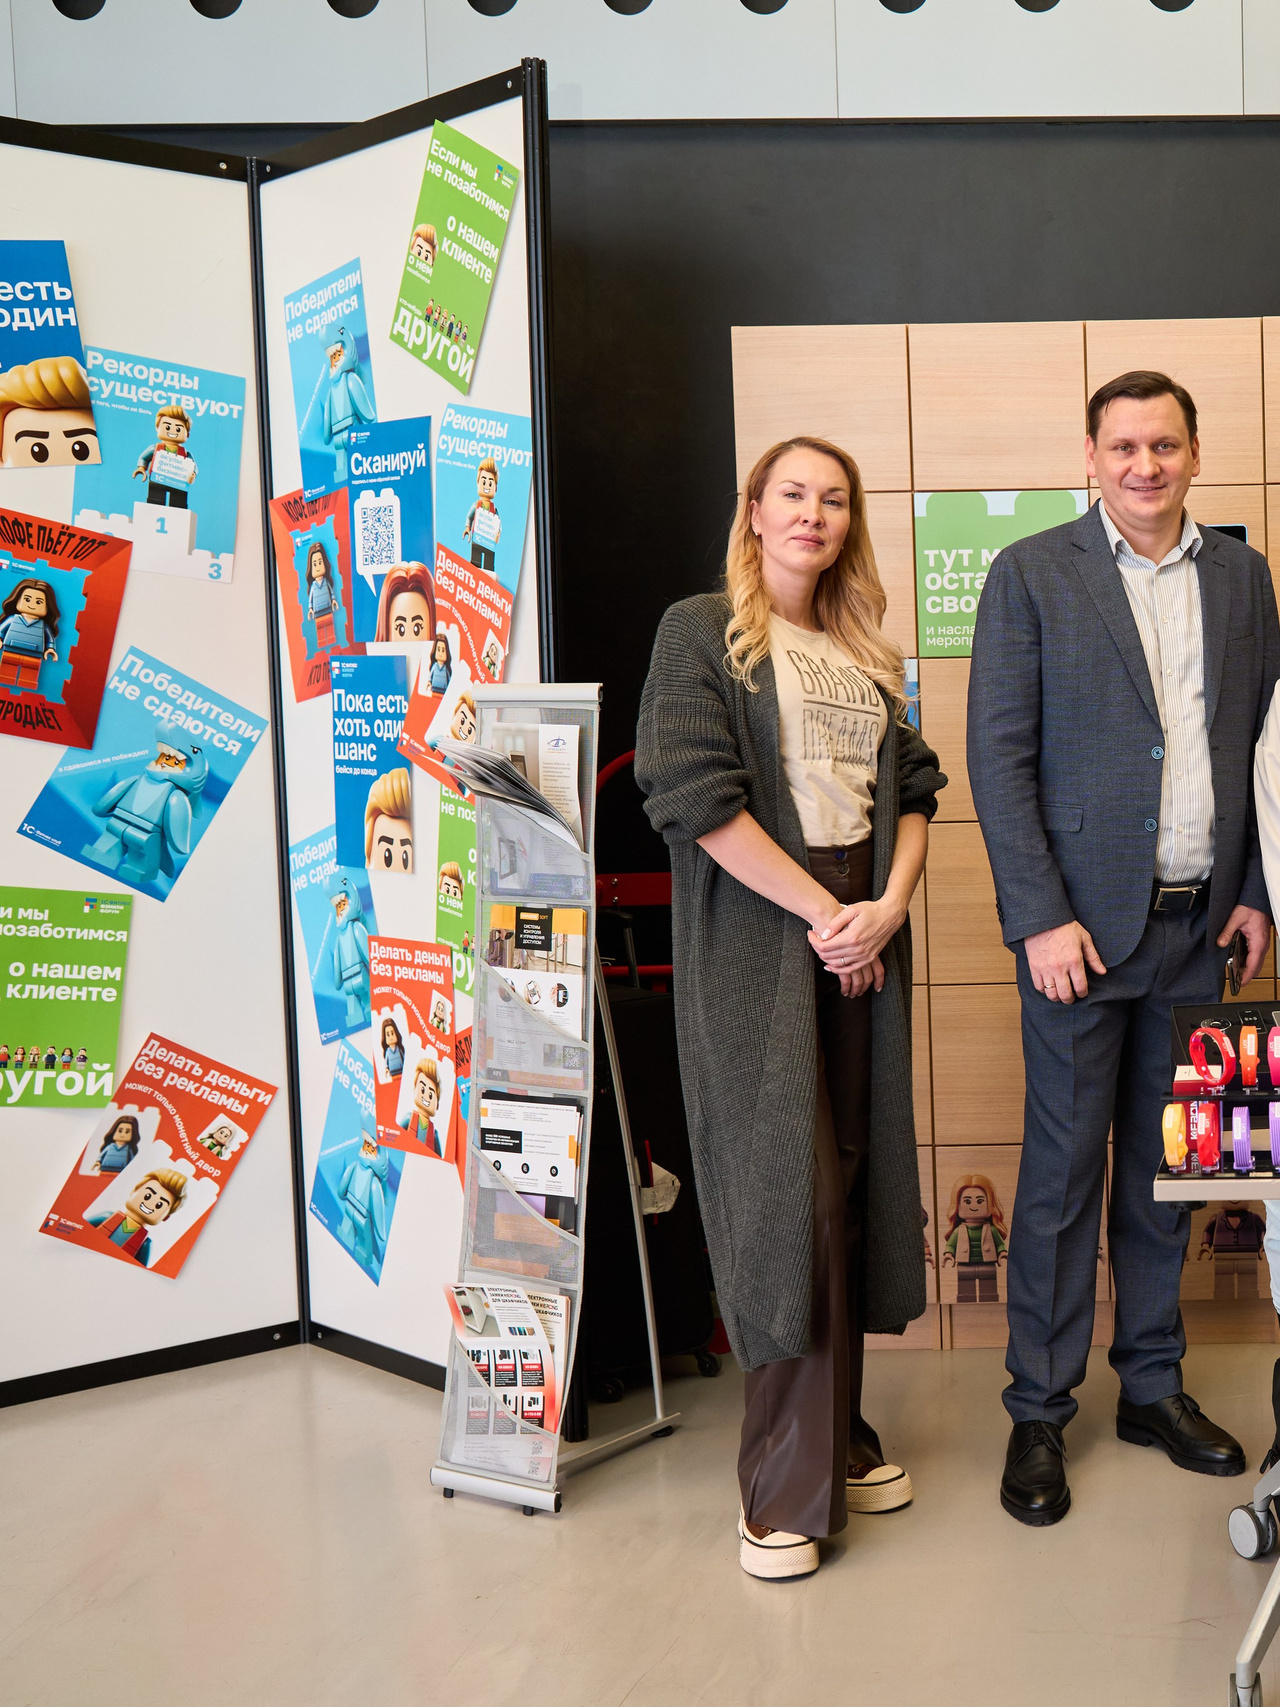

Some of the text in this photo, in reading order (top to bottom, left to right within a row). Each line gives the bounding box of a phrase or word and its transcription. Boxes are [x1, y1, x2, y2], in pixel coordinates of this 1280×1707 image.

[430, 138, 460, 168] Если
[460, 158, 477, 179] мы
[426, 159, 441, 179] не
[443, 168, 510, 222] позаботимся
[446, 215, 501, 263] о нашем
[415, 259, 433, 277] нем
[441, 237, 493, 285] клиенте
[285, 268, 362, 323] Победители
[287, 294, 359, 343] не сдаются
[393, 308, 475, 383] другой
[86, 350, 199, 390] Рекорды
[87, 375, 243, 419] существуют
[442, 408, 508, 438] Рекорды
[351, 443, 426, 476] Сканируй
[438, 434, 533, 469] существуют
[155, 517, 168, 534] 1
[36, 525, 77, 556] ПЬЁТ
[67, 536, 108, 562] ТОТ
[208, 563, 222, 580] 3
[924, 549, 974, 573] тут
[436, 549, 512, 617] Делать деньги
[435, 572, 502, 629] без рекламы
[926, 626, 934, 635] и
[120, 654, 262, 743] Победители
[333, 689, 409, 714] Пока есть
[108, 676, 242, 757] не сдаются
[334, 718, 371, 738] хоть
[111, 749, 149, 762] побеждают
[334, 742, 377, 761] шанс
[353, 767, 361, 775] до
[361, 767, 378, 776] конца
[441, 801, 456, 815] не
[294, 874, 308, 893] не
[18, 908, 49, 921] мы
[439, 894, 464, 911] о нем
[370, 941, 451, 968] Делать деньги
[9, 962, 122, 981] о нашем
[371, 960, 392, 977] без
[394, 965, 445, 985] рекламы
[7, 983, 117, 1002] клиенте
[373, 986, 393, 995] может
[393, 988, 412, 1006] только
[435, 1041, 451, 1055] двор
[134, 1057, 250, 1115] без рекламы
[141, 1039, 273, 1106] Делать деньги
[335, 1066, 350, 1089] не
[125, 1083, 222, 1177] может только монетный двор
